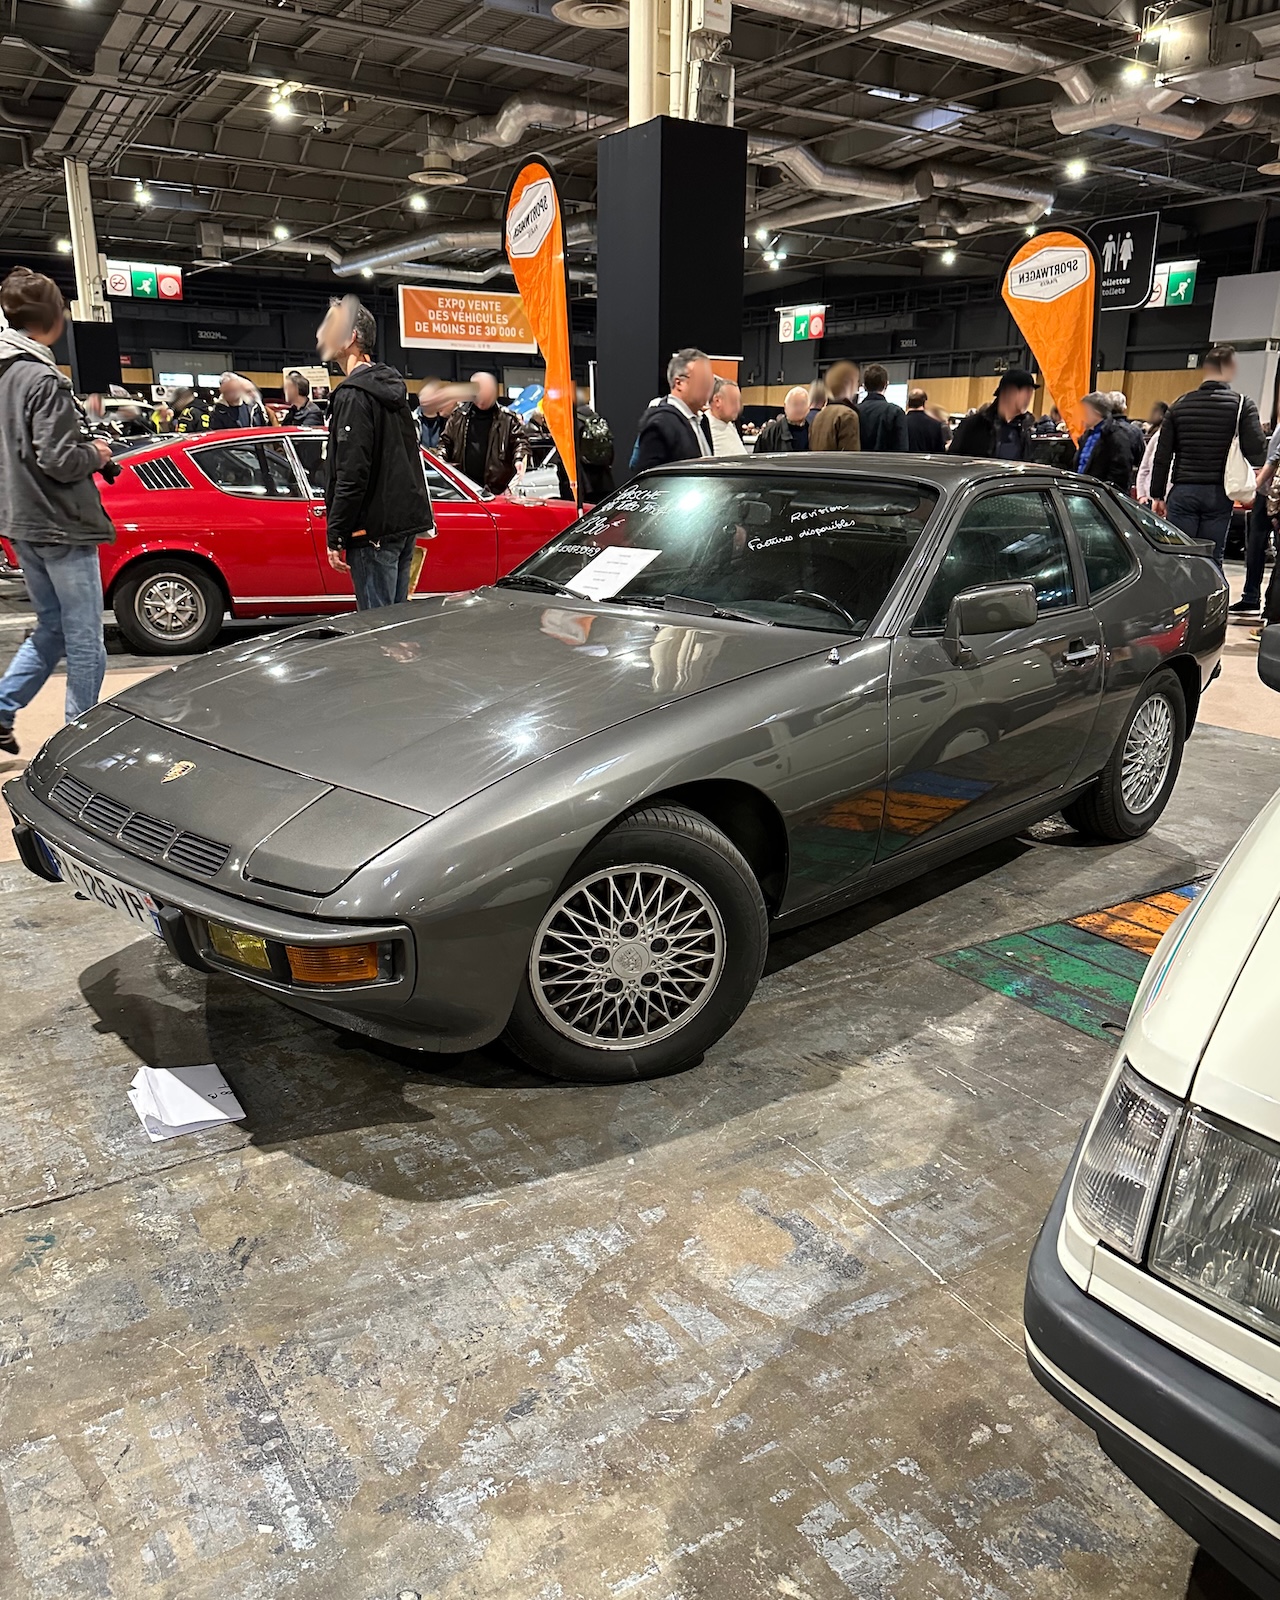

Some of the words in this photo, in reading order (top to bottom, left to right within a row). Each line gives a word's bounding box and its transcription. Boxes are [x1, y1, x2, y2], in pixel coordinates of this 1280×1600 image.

[1101, 278, 1130, 287] oilettes
[438, 298, 465, 309] EXPO
[468, 300, 501, 312] VENTE
[428, 310, 449, 321] DES
[451, 310, 508, 325] VÉHICULES
[415, 321, 429, 332] DE
[432, 323, 466, 335] MOINS
[469, 325, 482, 336] DE
[485, 326, 497, 336] 30
[498, 327, 516, 337] 000
[747, 536, 793, 551] Factures
[799, 519, 855, 538] disponibles
